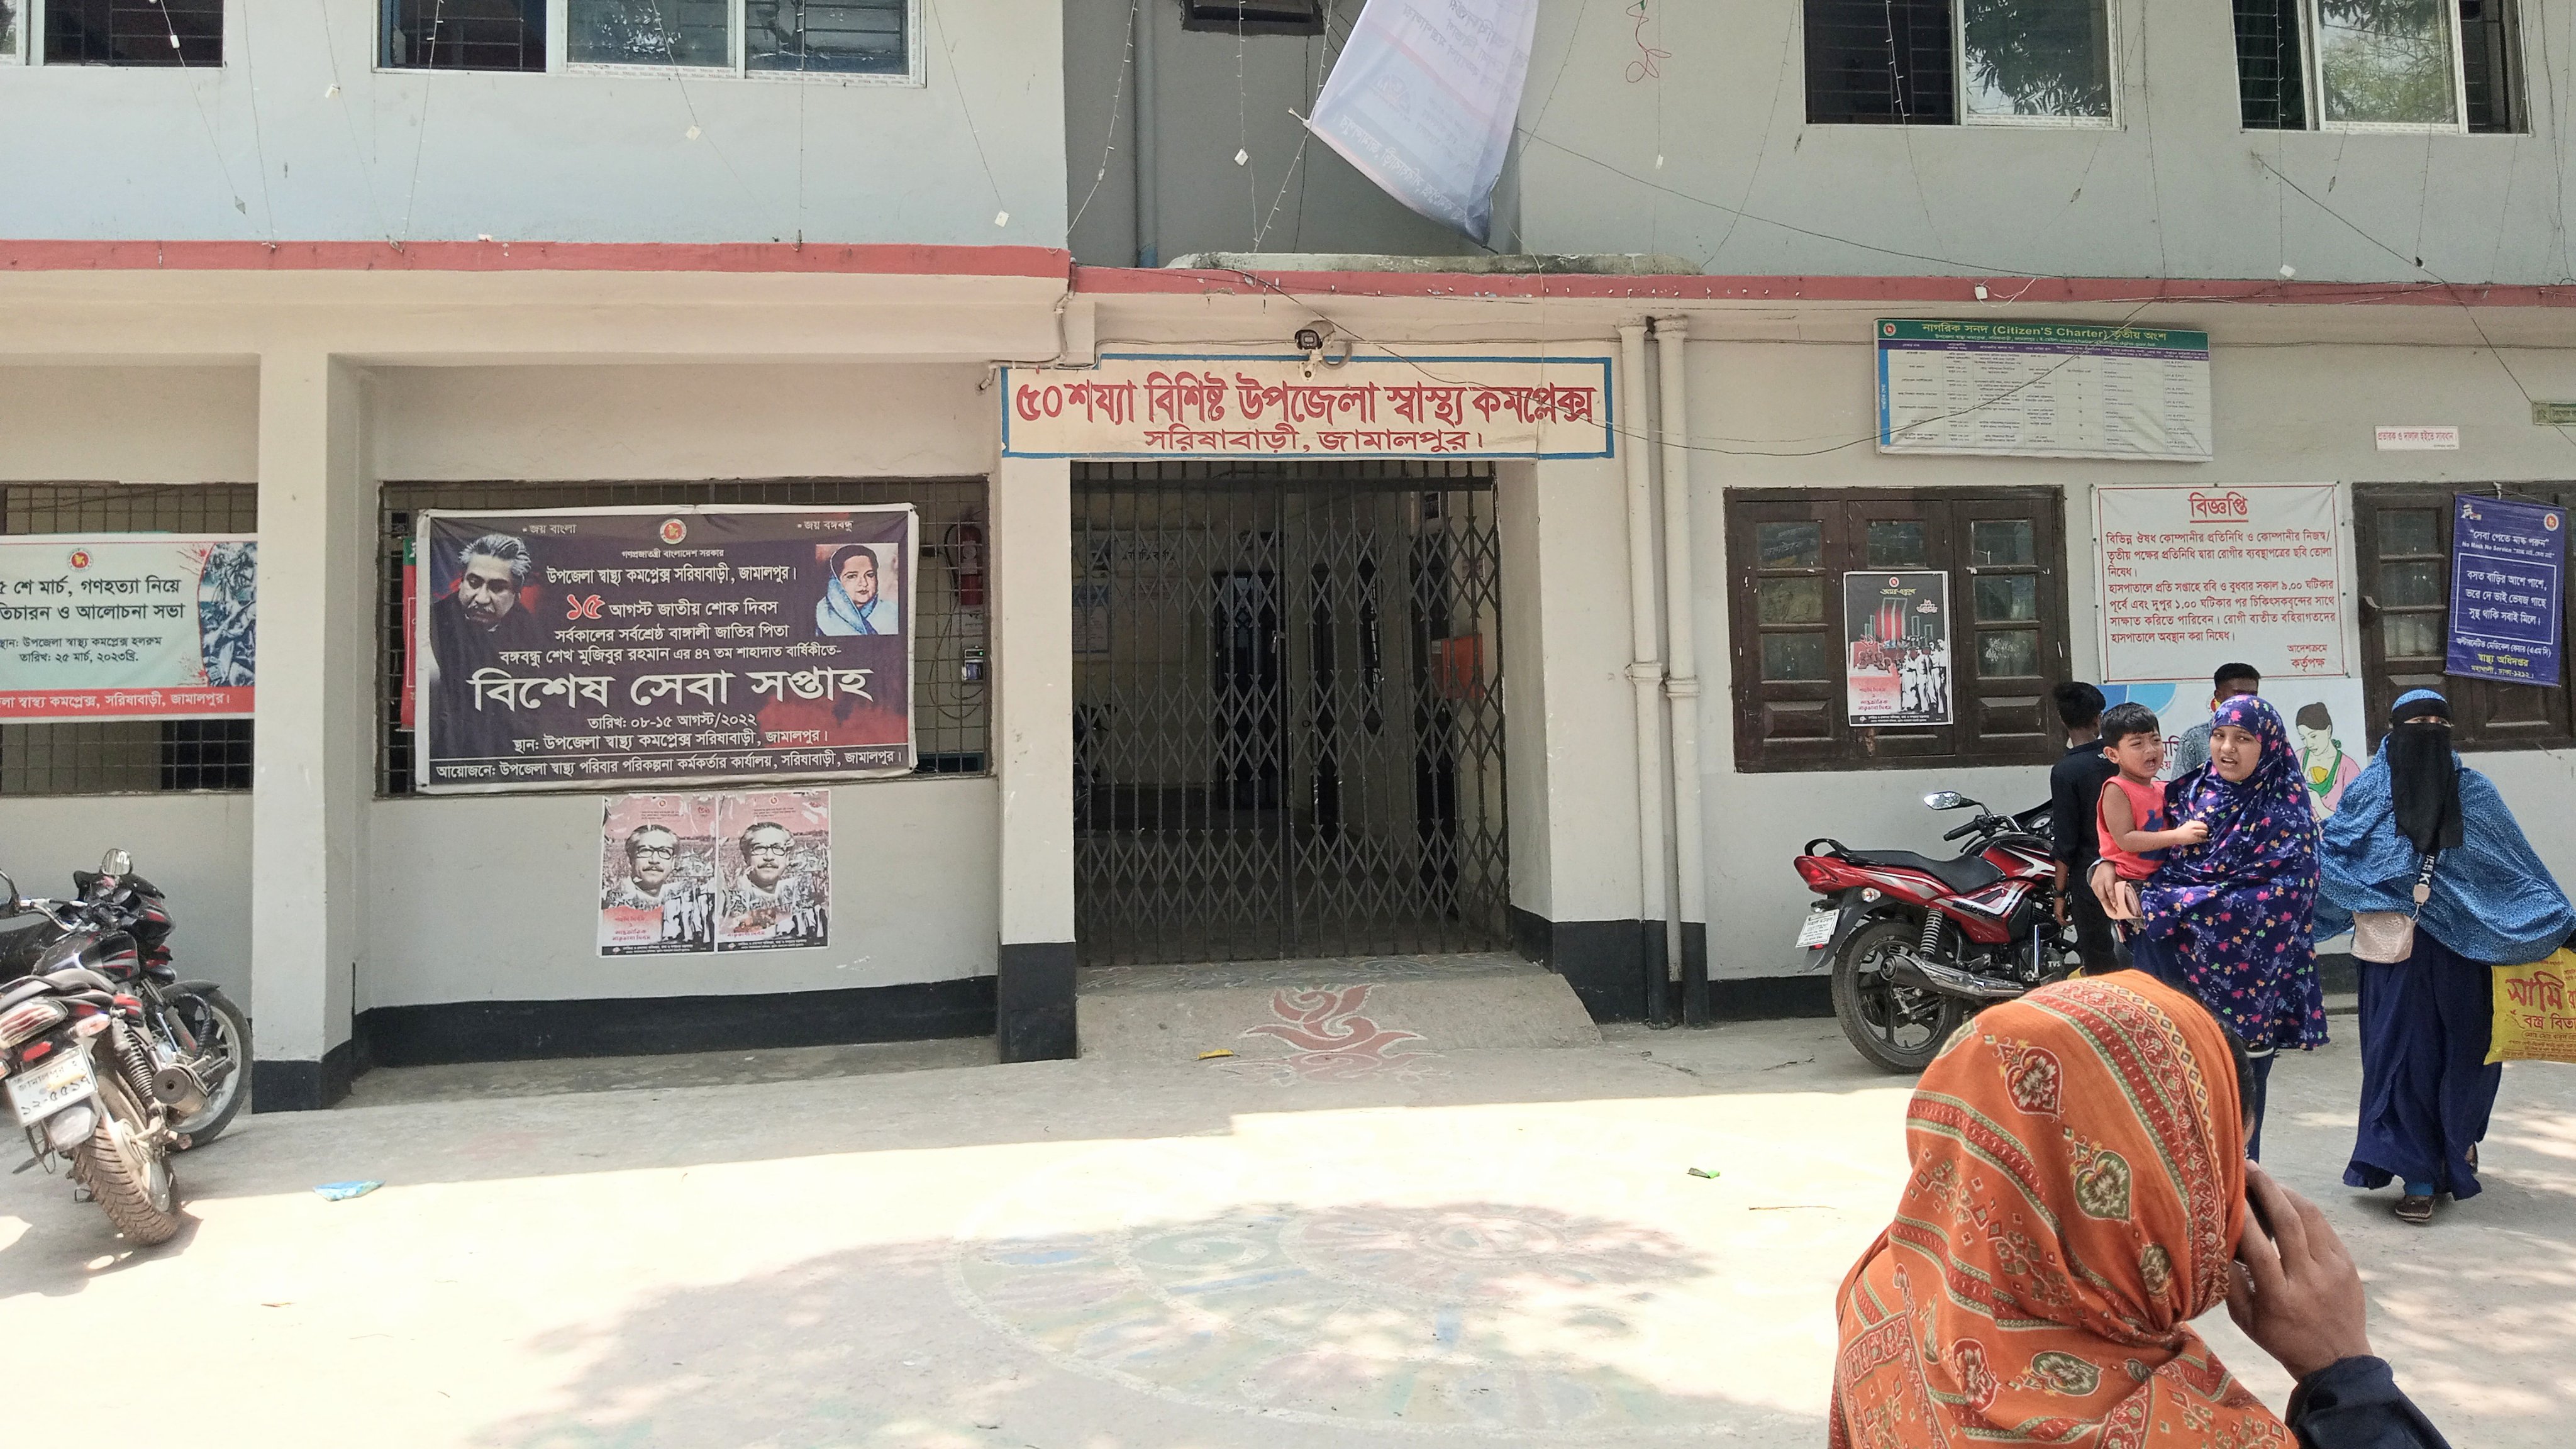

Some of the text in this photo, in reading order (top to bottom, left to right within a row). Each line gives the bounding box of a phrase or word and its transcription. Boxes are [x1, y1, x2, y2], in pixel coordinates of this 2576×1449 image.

[1922, 323, 1960, 333] নাগরিক
[1964, 325, 1989, 333] সনদ
[2057, 328, 2107, 338] Charter)
[2143, 332, 2167, 340] অংশ
[1016, 371, 1597, 428] ৫০ শয্যা বিশিষ্ট উপজেলা স্বাস্থ্য কমপ্লেক্স
[1143, 423, 1310, 453] সরিষাবাড়ী,
[2188, 491, 2248, 518] বিজ্ঞপ্তি
[550, 524, 577, 534] বাংলা
[2107, 529, 2301, 545] বিভিন্ন ঔষধ কোম্পানীর প্রতিনিধি কোম্পানীর
[663, 549, 724, 558] বাংলাদেশ সরকার
[2107, 545, 2332, 565] তৃতীয় পক্ষের প্রতিনিধি দ্বারা রোগীর ছবি তোলা
[547, 566, 594, 584] উপজেলা
[598, 569, 623, 586] স্বাস্থ্য
[626, 568, 671, 584] কমপ্লেক্স
[674, 563, 735, 585] সরিষাবাড়ী,
[2467, 570, 2485, 581] বসত
[2487, 570, 2506, 586] বাড়ির
[2507, 575, 2526, 587] আশে
[14, 575, 181, 597] শে মার্চ, গণহত্যা নিয়ে
[2108, 577, 2334, 594] হাসপাতালে প্রতি সপ্তাহে রবি ও বুধবার সকাল ৯.০০ ঘটিকার
[0, 602, 186, 621] তিচারন ও আলোচনা সভা
[566, 593, 779, 621] ১৫ আগস্ট জাতীয় শোক দিবস
[2110, 597, 2128, 613] পূর্বে
[2131, 600, 2149, 610] এবং
[2151, 599, 2172, 612] দুপুর
[2175, 600, 2197, 609] ১.০০
[2200, 596, 2231, 609] ঘটিকার
[2235, 598, 2247, 608] পর
[2315, 596, 2334, 606] সাথে
[2143, 613, 2174, 626] করিতে
[2224, 611, 2246, 624] রোগী
[2249, 611, 2279, 624] ব্যতীত
[2281, 611, 2336, 624] বহিরাগতদের
[2482, 607, 2500, 620] থাকি
[2501, 611, 2519, 624] সবাই
[554, 621, 790, 643] সর্বকালের সর্বশ্রেষ্ঠ বাঙ্গালী জাতির পিতা
[2111, 631, 2204, 644] হাসপাতালে অবস্থান করা
[23, 636, 62, 647] উপজেলা
[65, 638, 89, 649] স্বাস্থ্য
[91, 638, 128, 647] কমপ্লেক্স
[55, 653, 69, 663] ২৫
[499, 645, 783, 668] বঙ্গবন্ধু শেখ মুজিবুর রহমান এর ৪৭ তম শাহাদাত
[2290, 655, 2325, 672] কর্তৃপক্ষ
[466, 665, 874, 712] বিশেষ সেবা সপ্তাহ
[18, 696, 47, 708] স্বাস্থ্য
[105, 691, 166, 708] সরিষাবাড়ী,
[631, 716, 673, 730] ০৮-১৫
[543, 734, 601, 750] উপজেলা
[606, 735, 634, 751] স্বাস্থ্য
[638, 731, 692, 748] কমপ্লেক্স
[696, 728, 762, 747] সরিষাবাড়ী,
[499, 761, 548, 778] উপজেলা
[550, 761, 575, 777] স্বাস্থ্য
[579, 758, 619, 774] পরিবার
[622, 757, 674, 773] পরিকল্পনা
[677, 752, 727, 770] কর্মকর্তার
[781, 749, 841, 768] সরিষাবাড়ী,
[2506, 970, 2565, 1012] সামি
